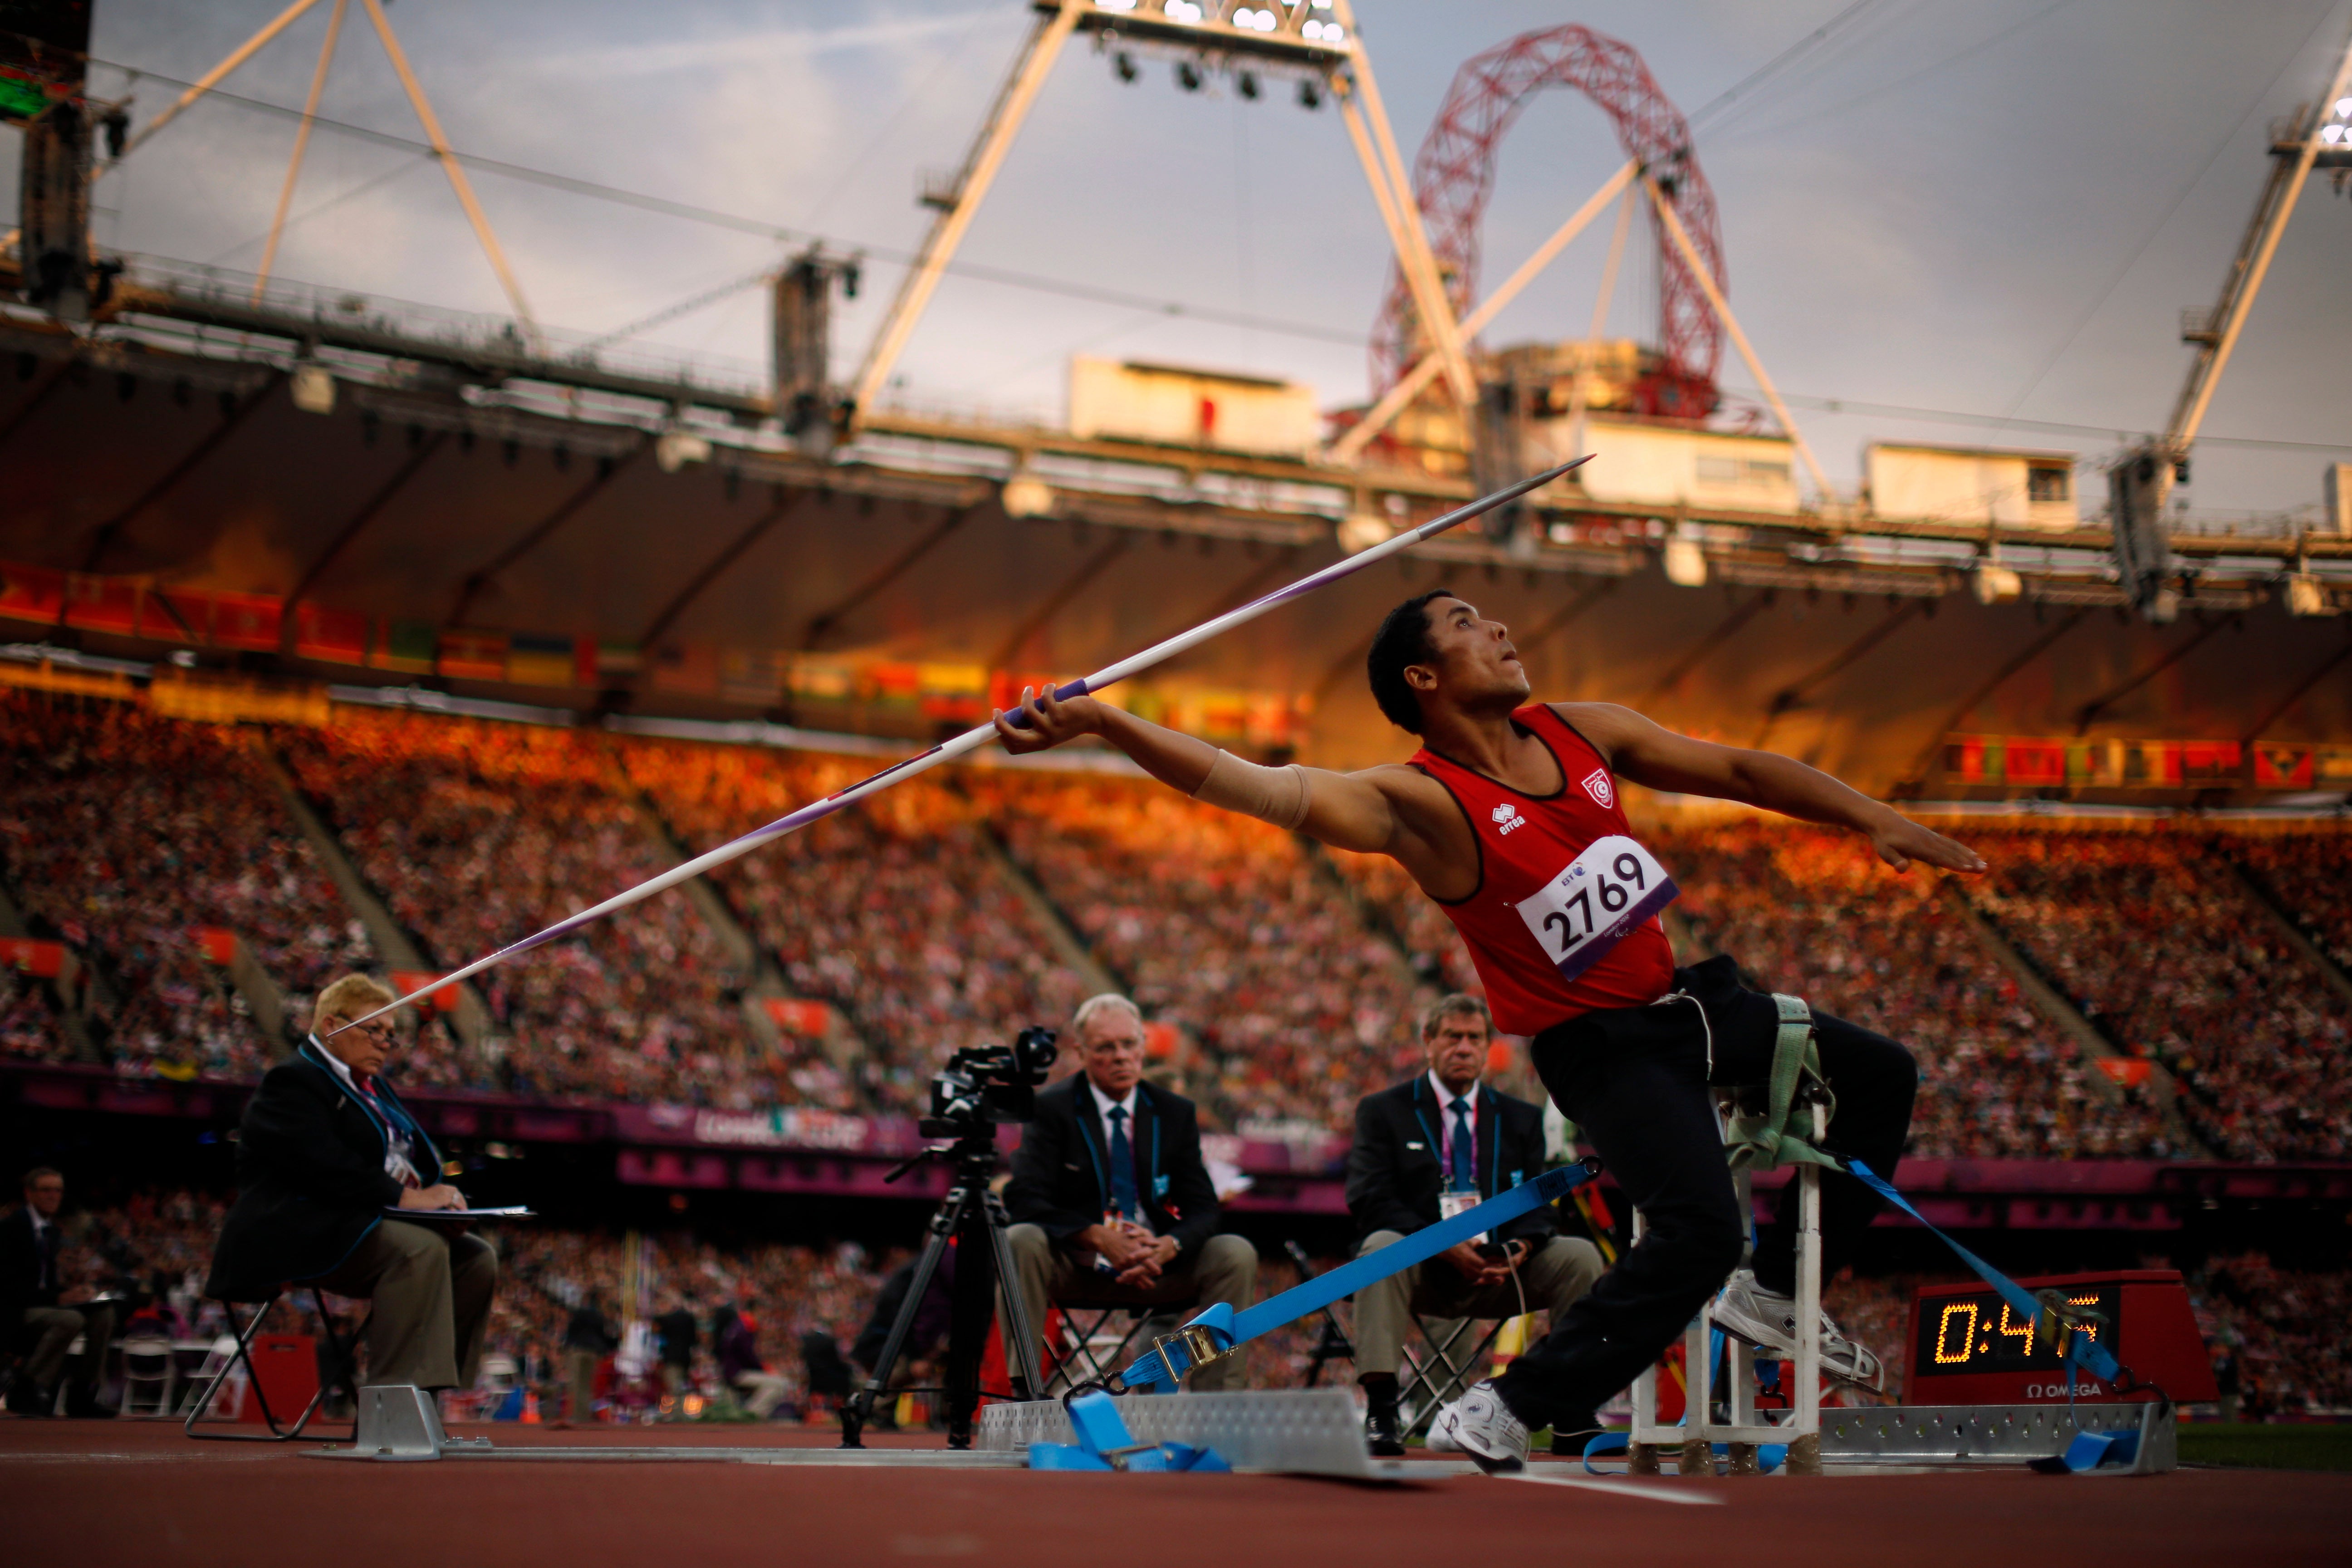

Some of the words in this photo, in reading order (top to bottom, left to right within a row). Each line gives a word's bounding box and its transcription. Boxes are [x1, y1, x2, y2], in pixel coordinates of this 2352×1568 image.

[1499, 815, 1525, 835] errea
[1561, 872, 1574, 887] BT
[1543, 853, 1645, 952] 2769
[1603, 923, 1620, 937] London
[1618, 914, 1630, 924] 2012
